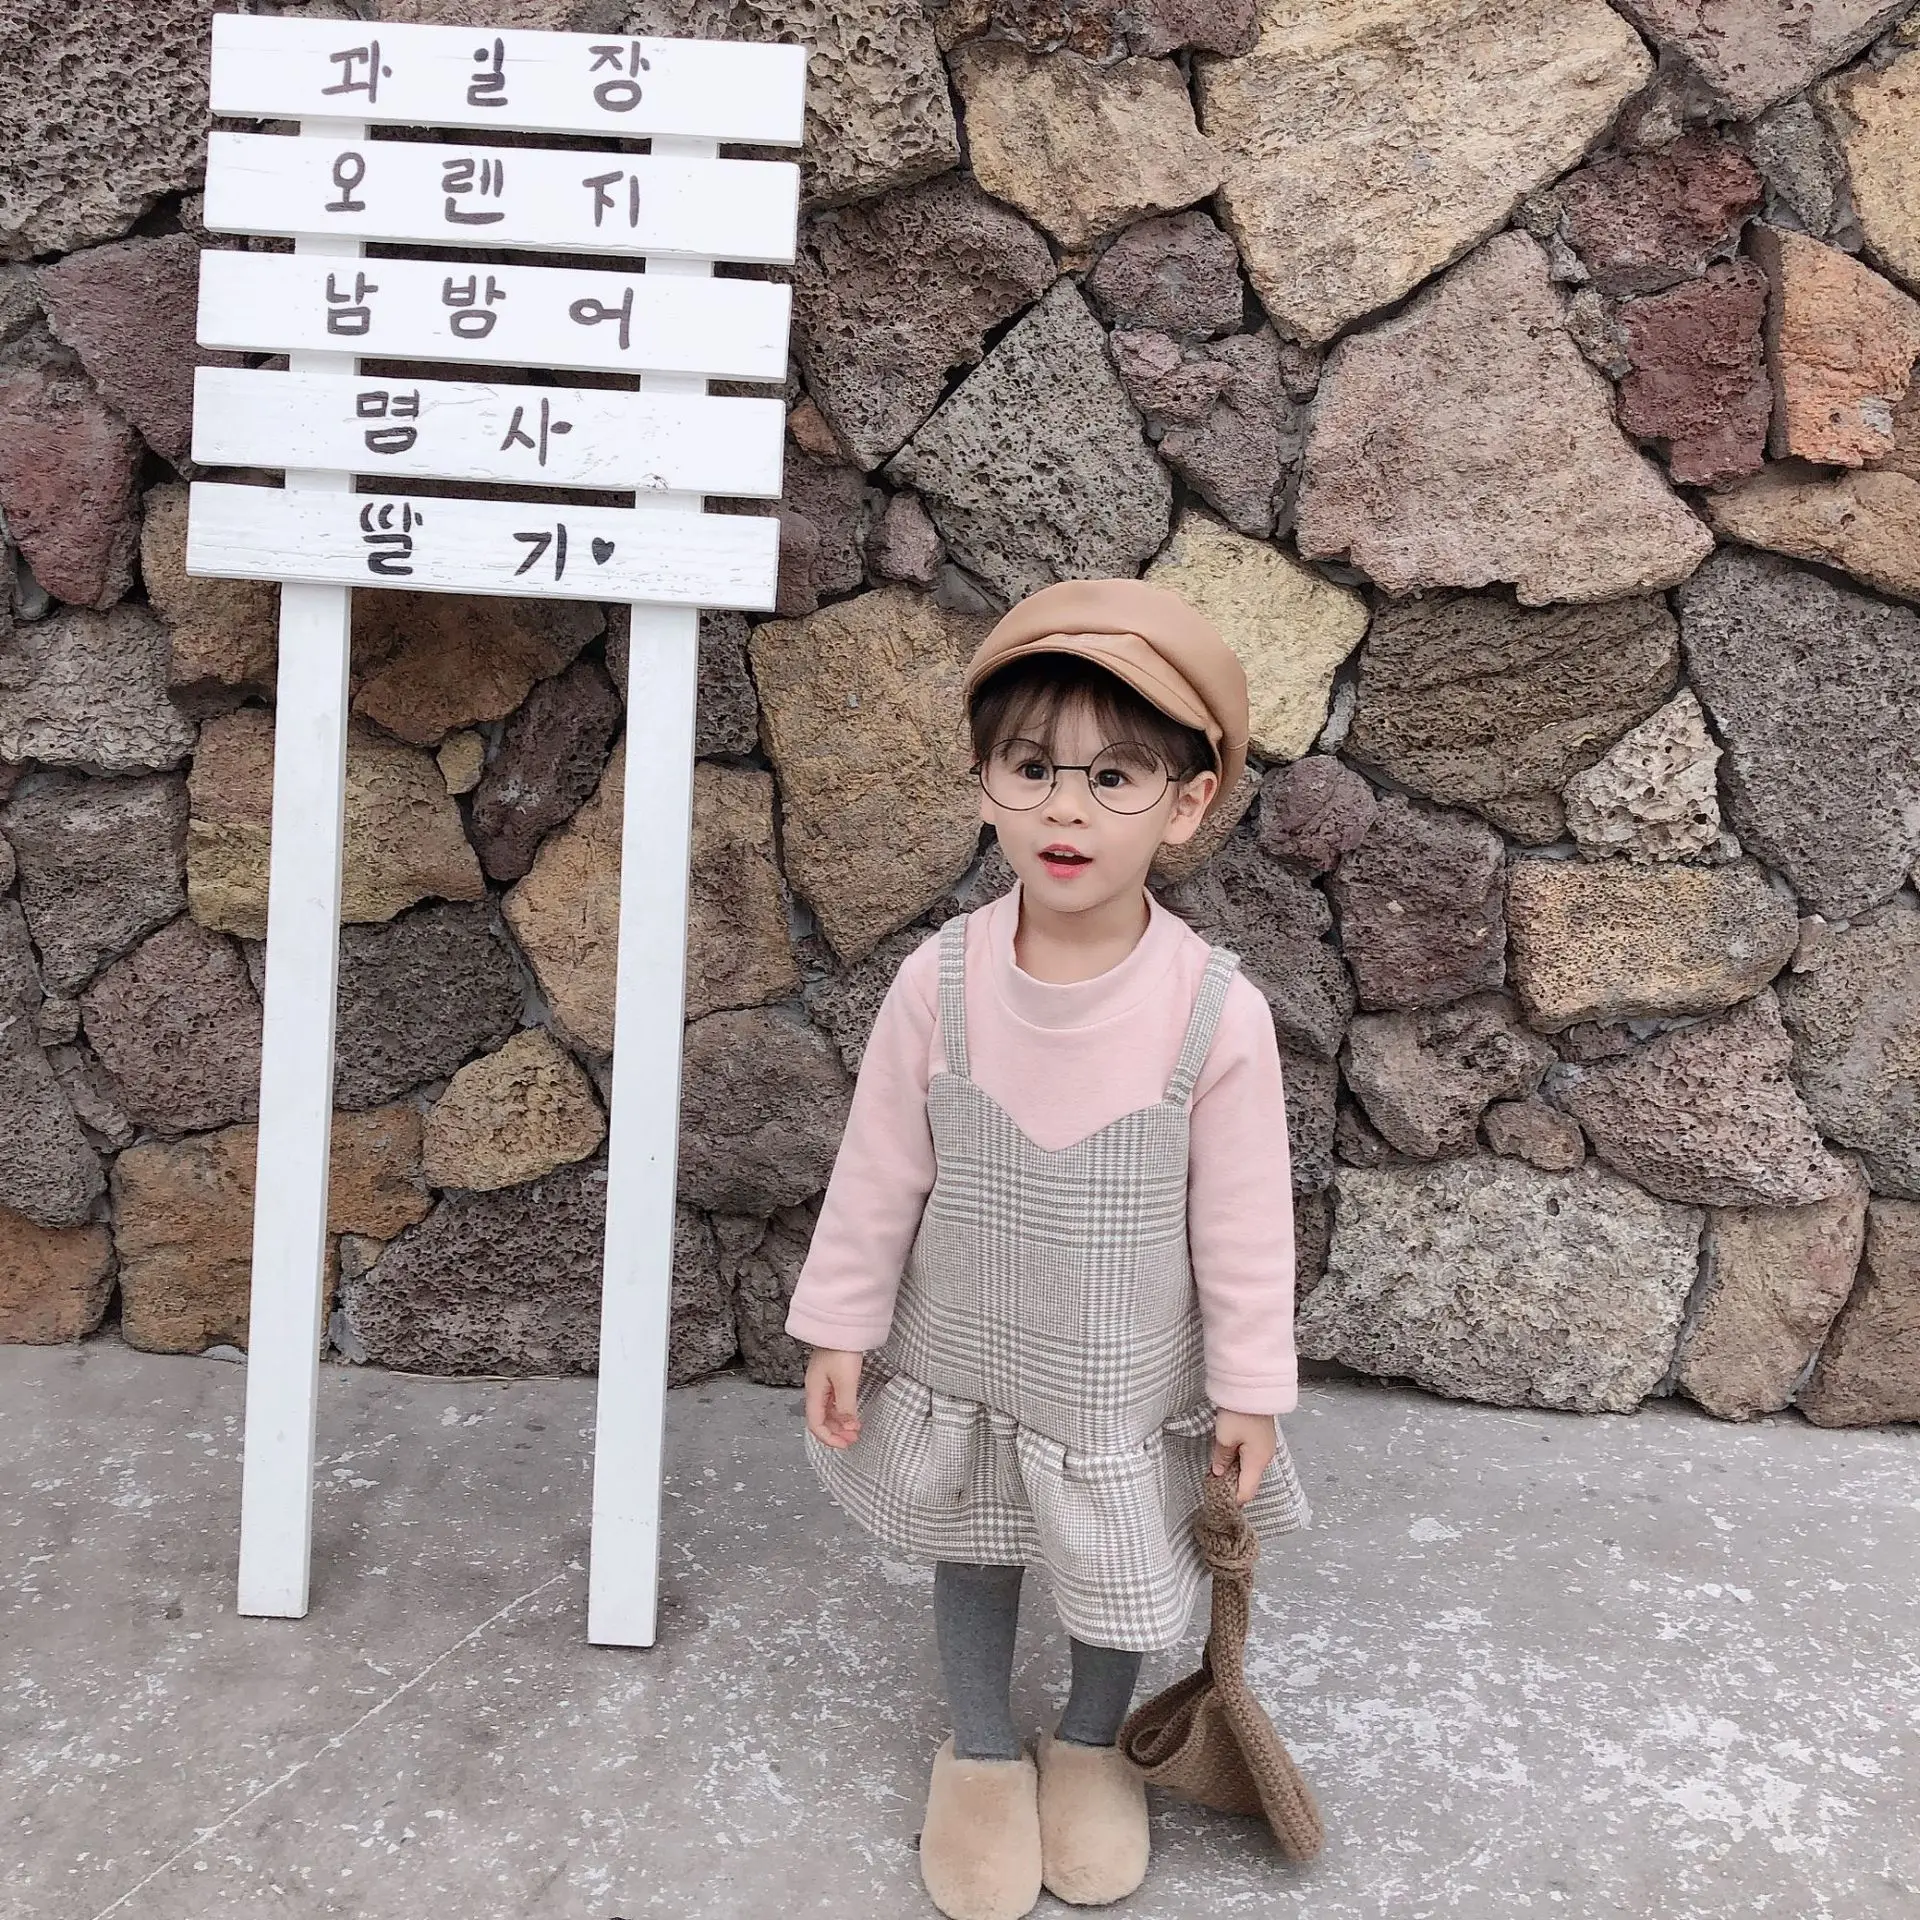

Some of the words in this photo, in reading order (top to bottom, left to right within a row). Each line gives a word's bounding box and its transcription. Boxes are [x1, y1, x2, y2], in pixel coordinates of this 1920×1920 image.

[321, 37, 651, 113] 과일장
[325, 151, 641, 229] 오렌지
[326, 271, 634, 350] 남방어
[359, 502, 569, 582] 딸기
